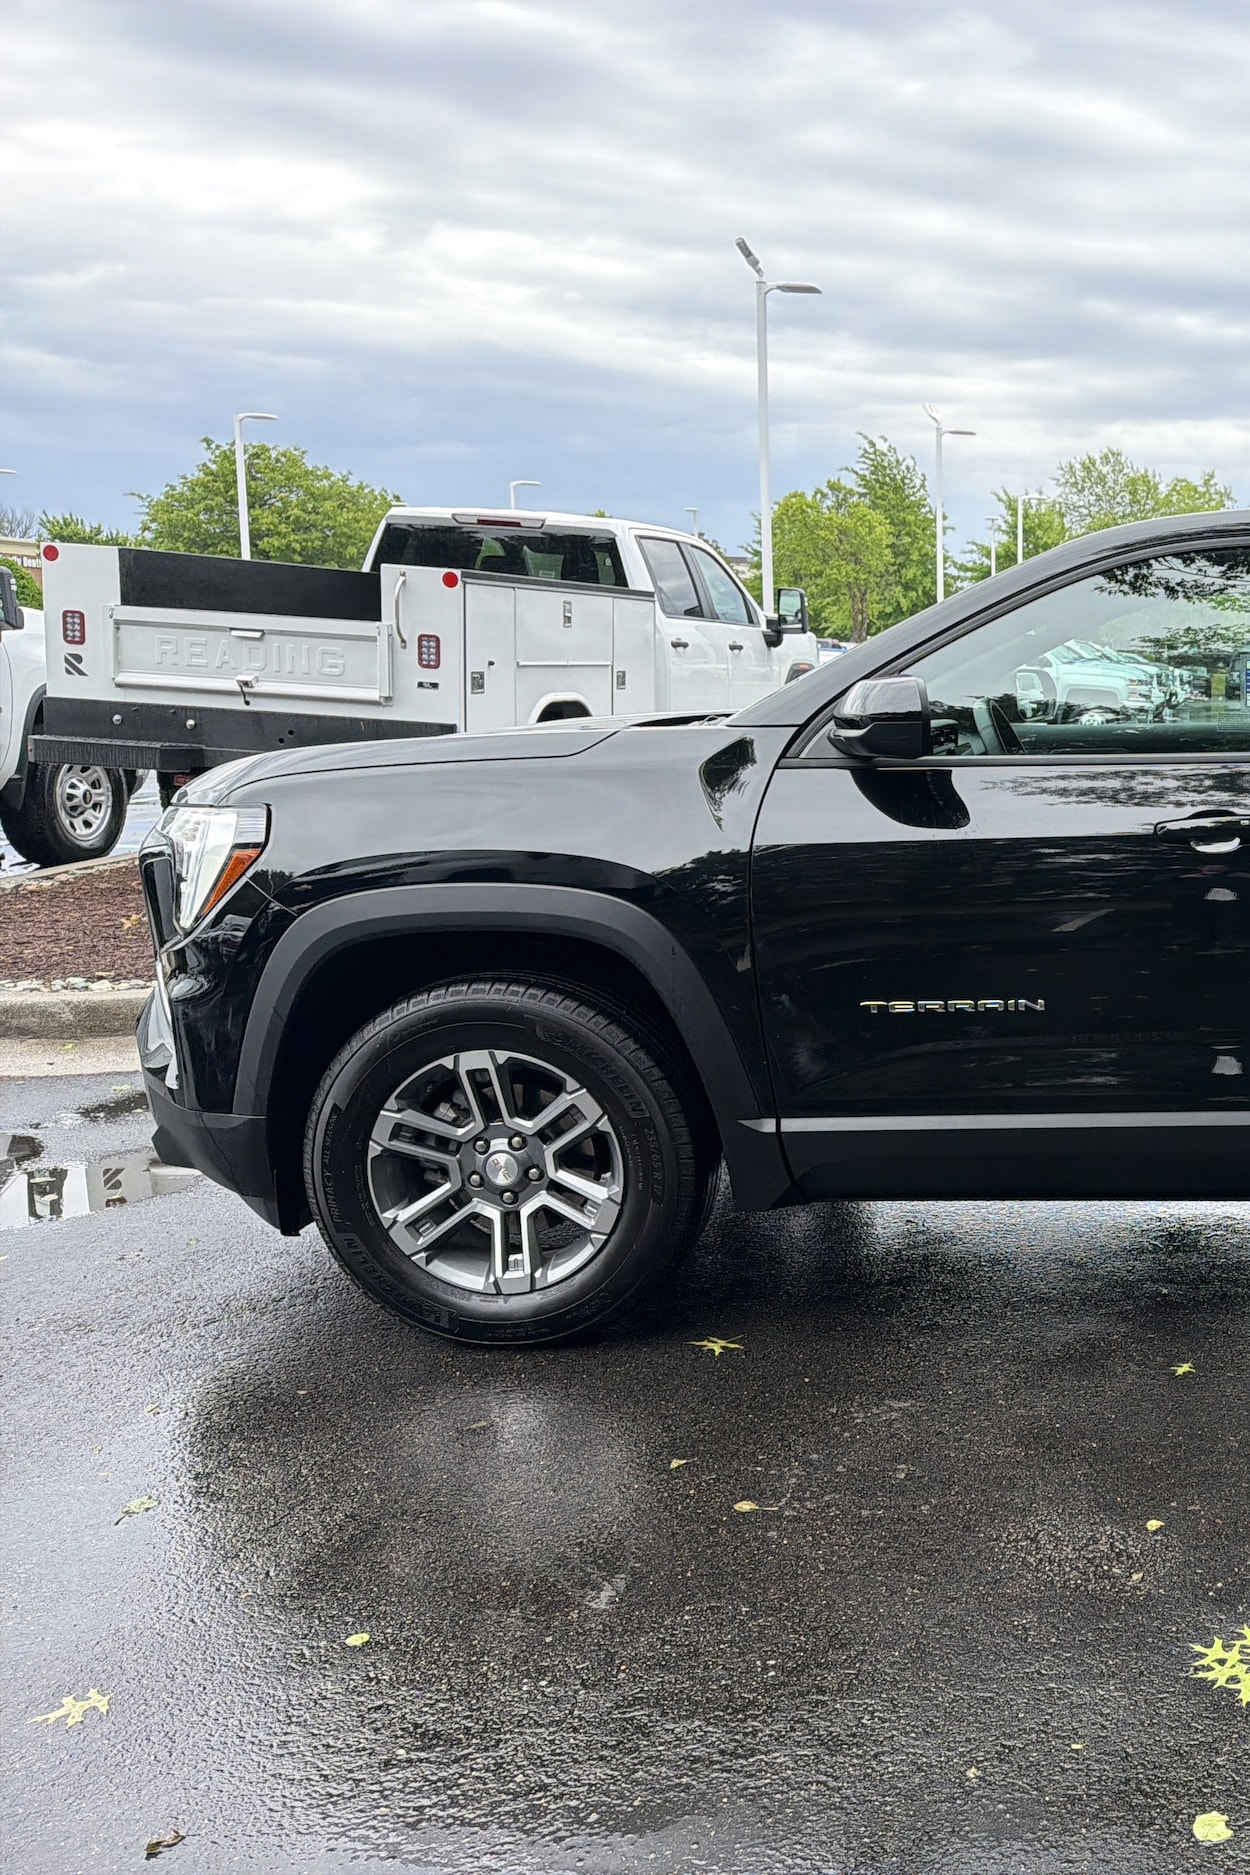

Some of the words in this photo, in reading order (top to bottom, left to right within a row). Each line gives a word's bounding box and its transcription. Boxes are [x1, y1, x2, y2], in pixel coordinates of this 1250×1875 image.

[154, 634, 345, 677] READING
[859, 999, 1046, 1014] TERRAIN
[323, 1167, 343, 1223] PRIMACY
